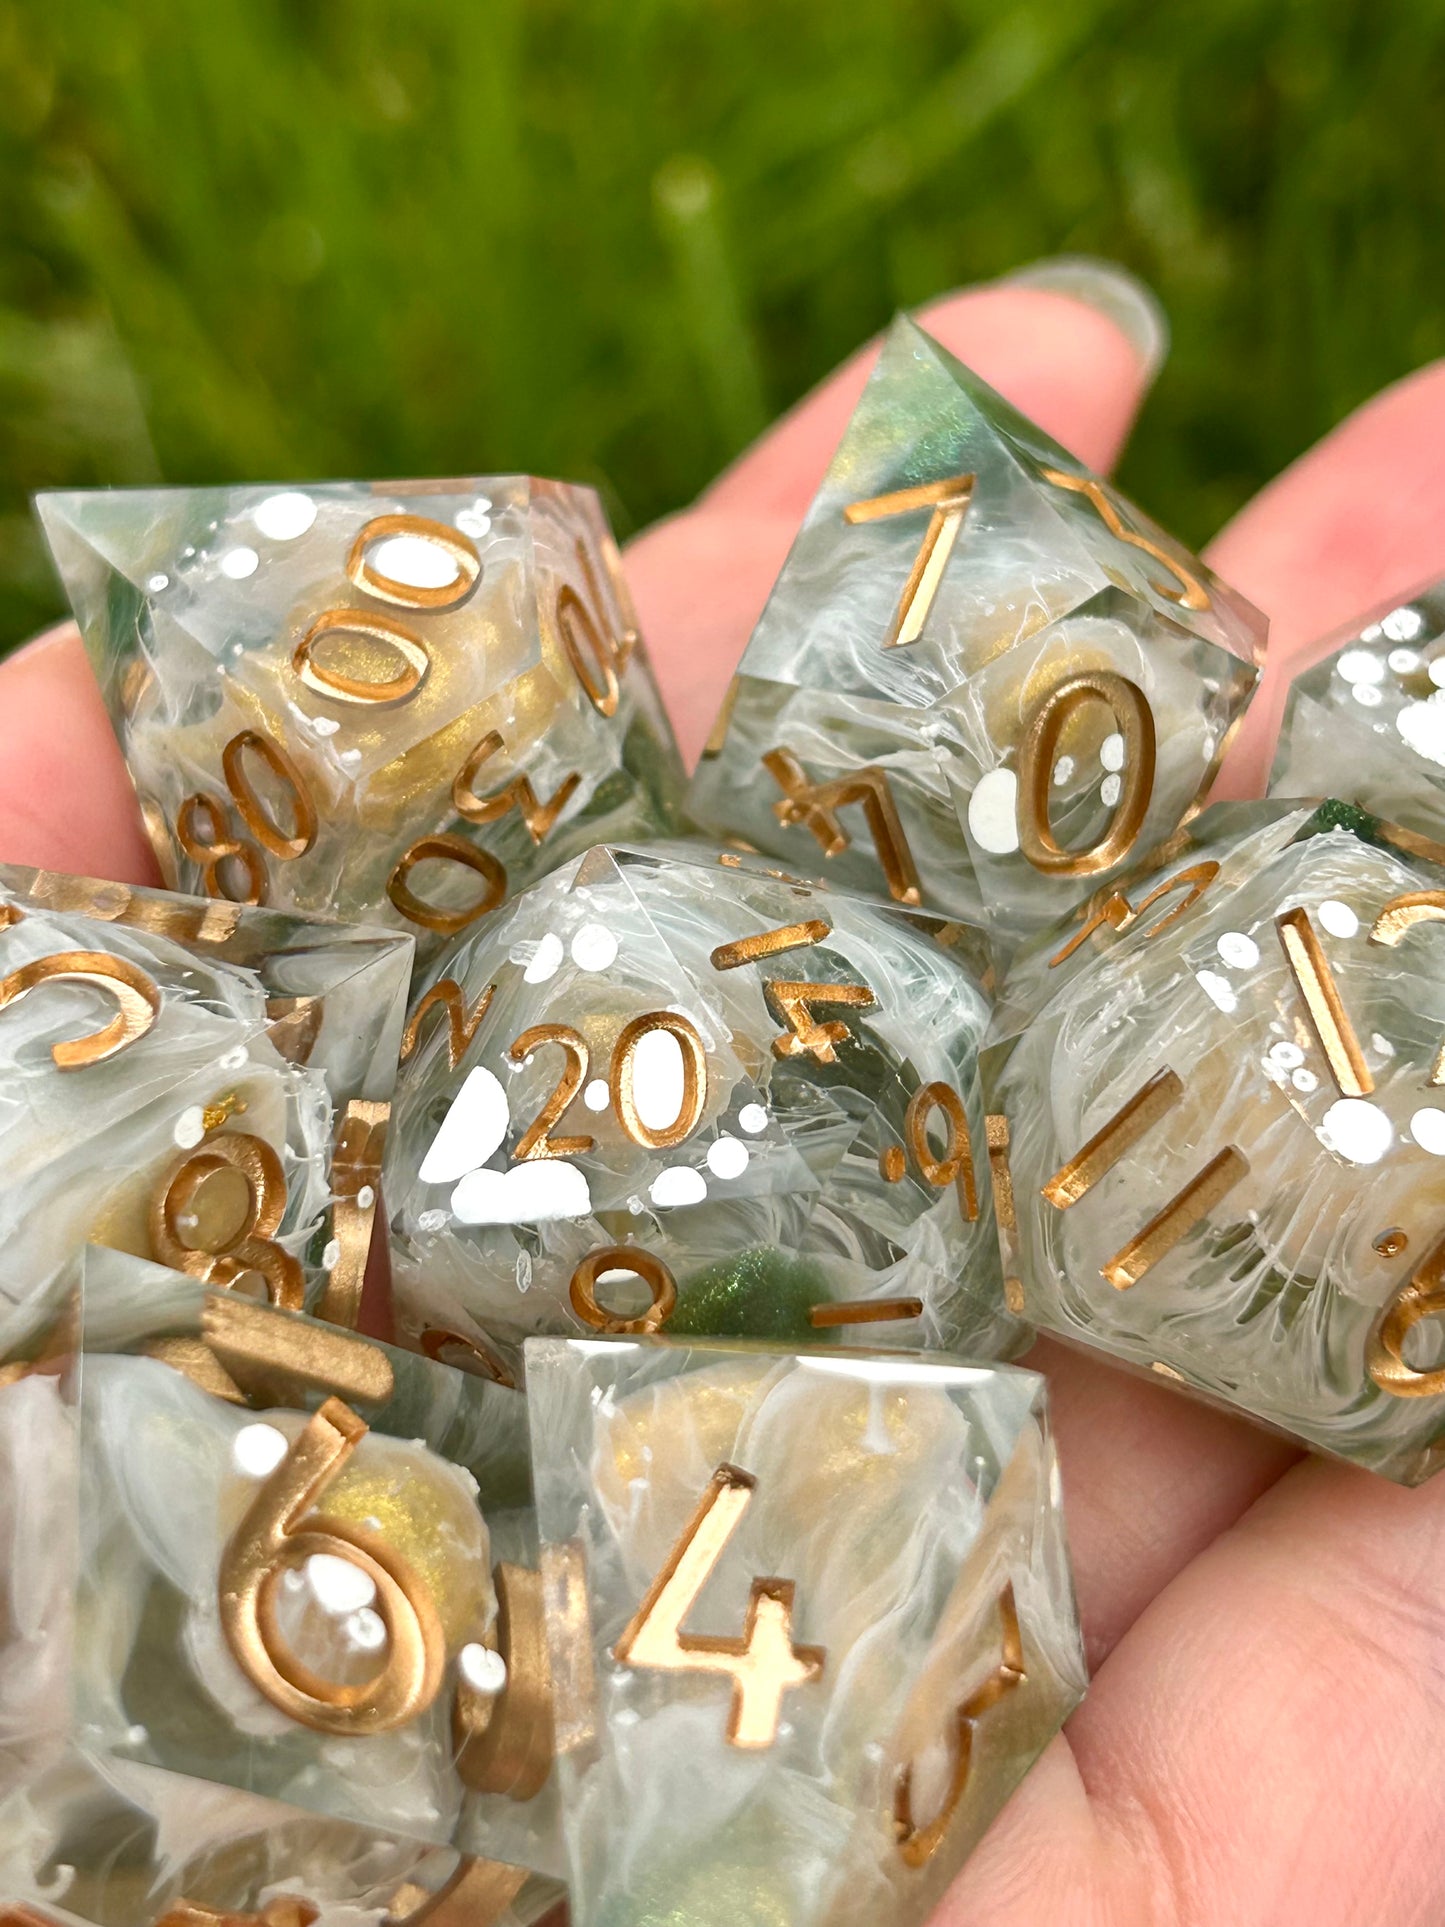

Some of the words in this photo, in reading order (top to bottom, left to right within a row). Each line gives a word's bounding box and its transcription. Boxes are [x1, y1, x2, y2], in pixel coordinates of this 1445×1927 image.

[843, 473, 976, 649] 7
[1017, 669, 1157, 879] 0
[510, 1011, 709, 1161] 20
[218, 1395, 447, 1736] 6
[613, 1462, 828, 1750] 4
